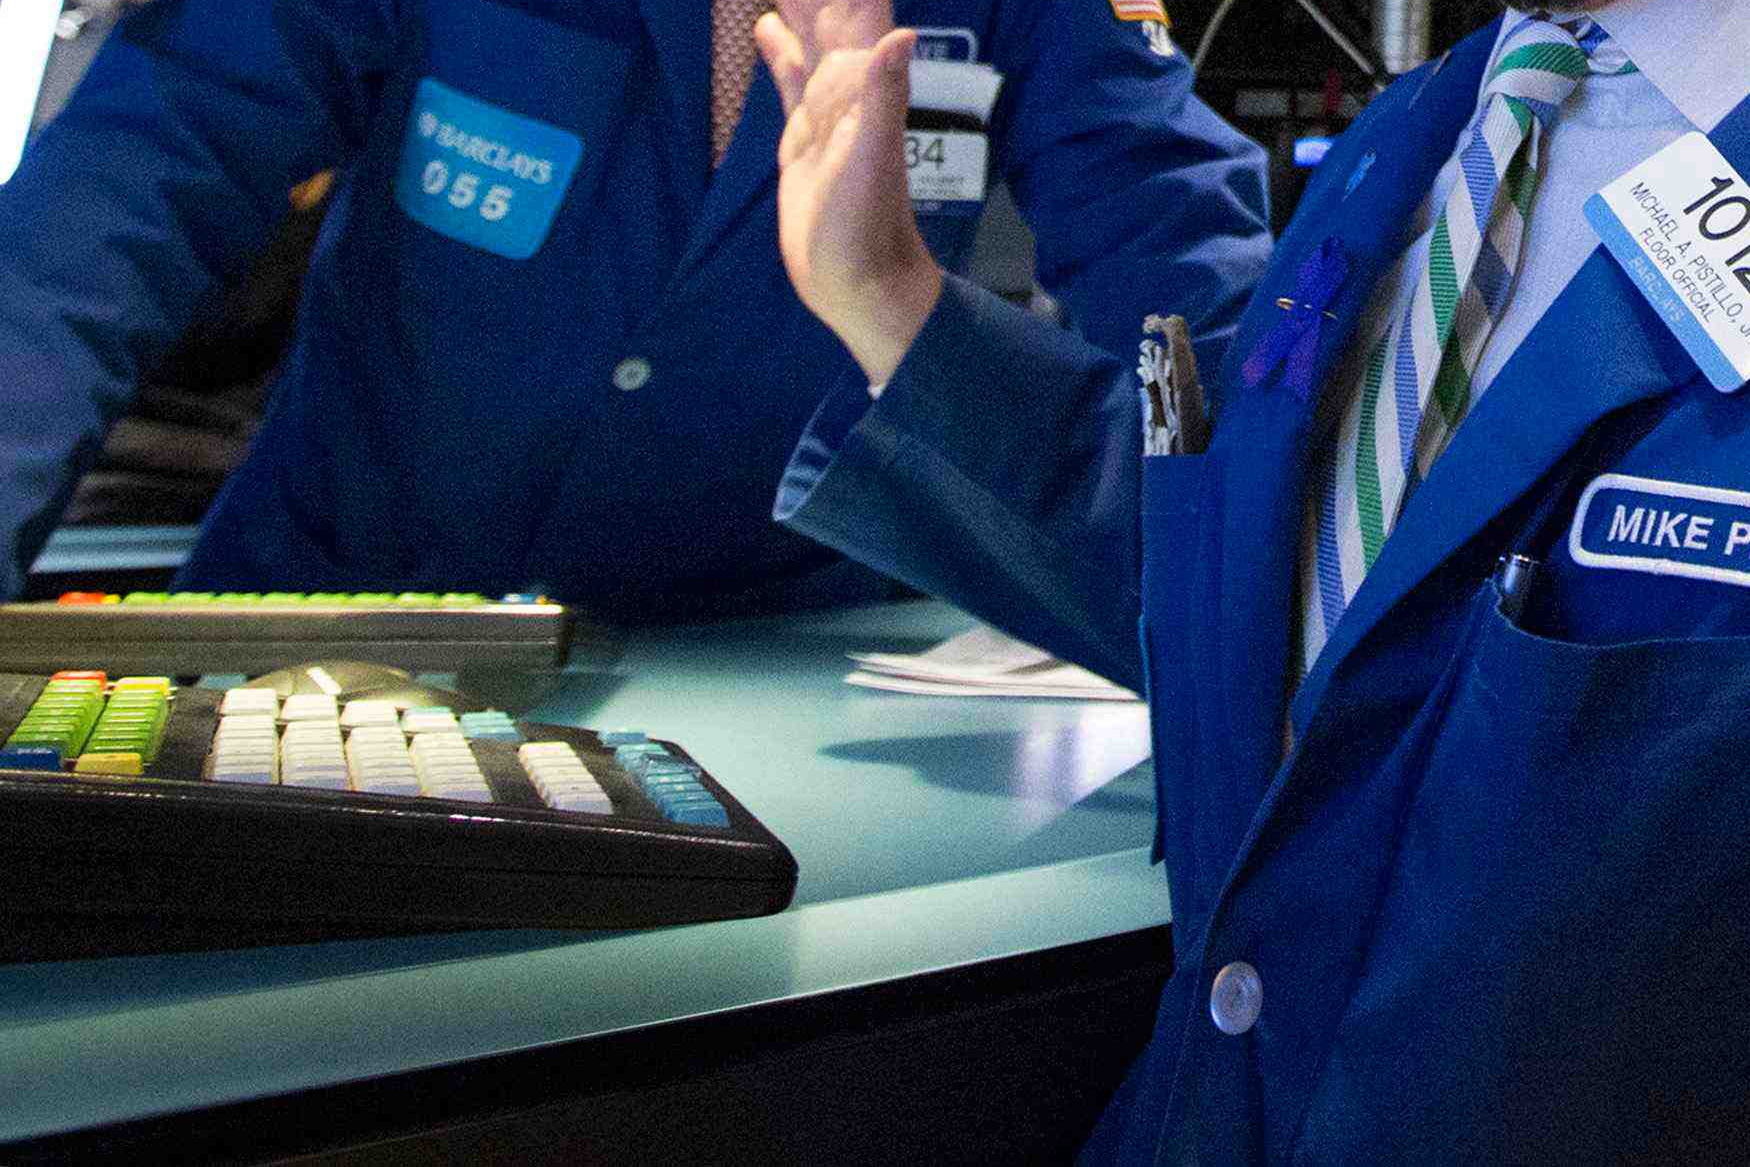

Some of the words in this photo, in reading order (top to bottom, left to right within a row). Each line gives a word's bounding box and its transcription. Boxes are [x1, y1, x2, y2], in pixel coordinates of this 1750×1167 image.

[1630, 181, 1677, 244] MICHAEL
[1675, 240, 1690, 260] A.
[1693, 252, 1744, 325] PISTILLO,
[1637, 226, 1676, 270] FLOOR
[1671, 266, 1715, 324] OFFICIAL
[1606, 504, 1715, 551] MIKE
